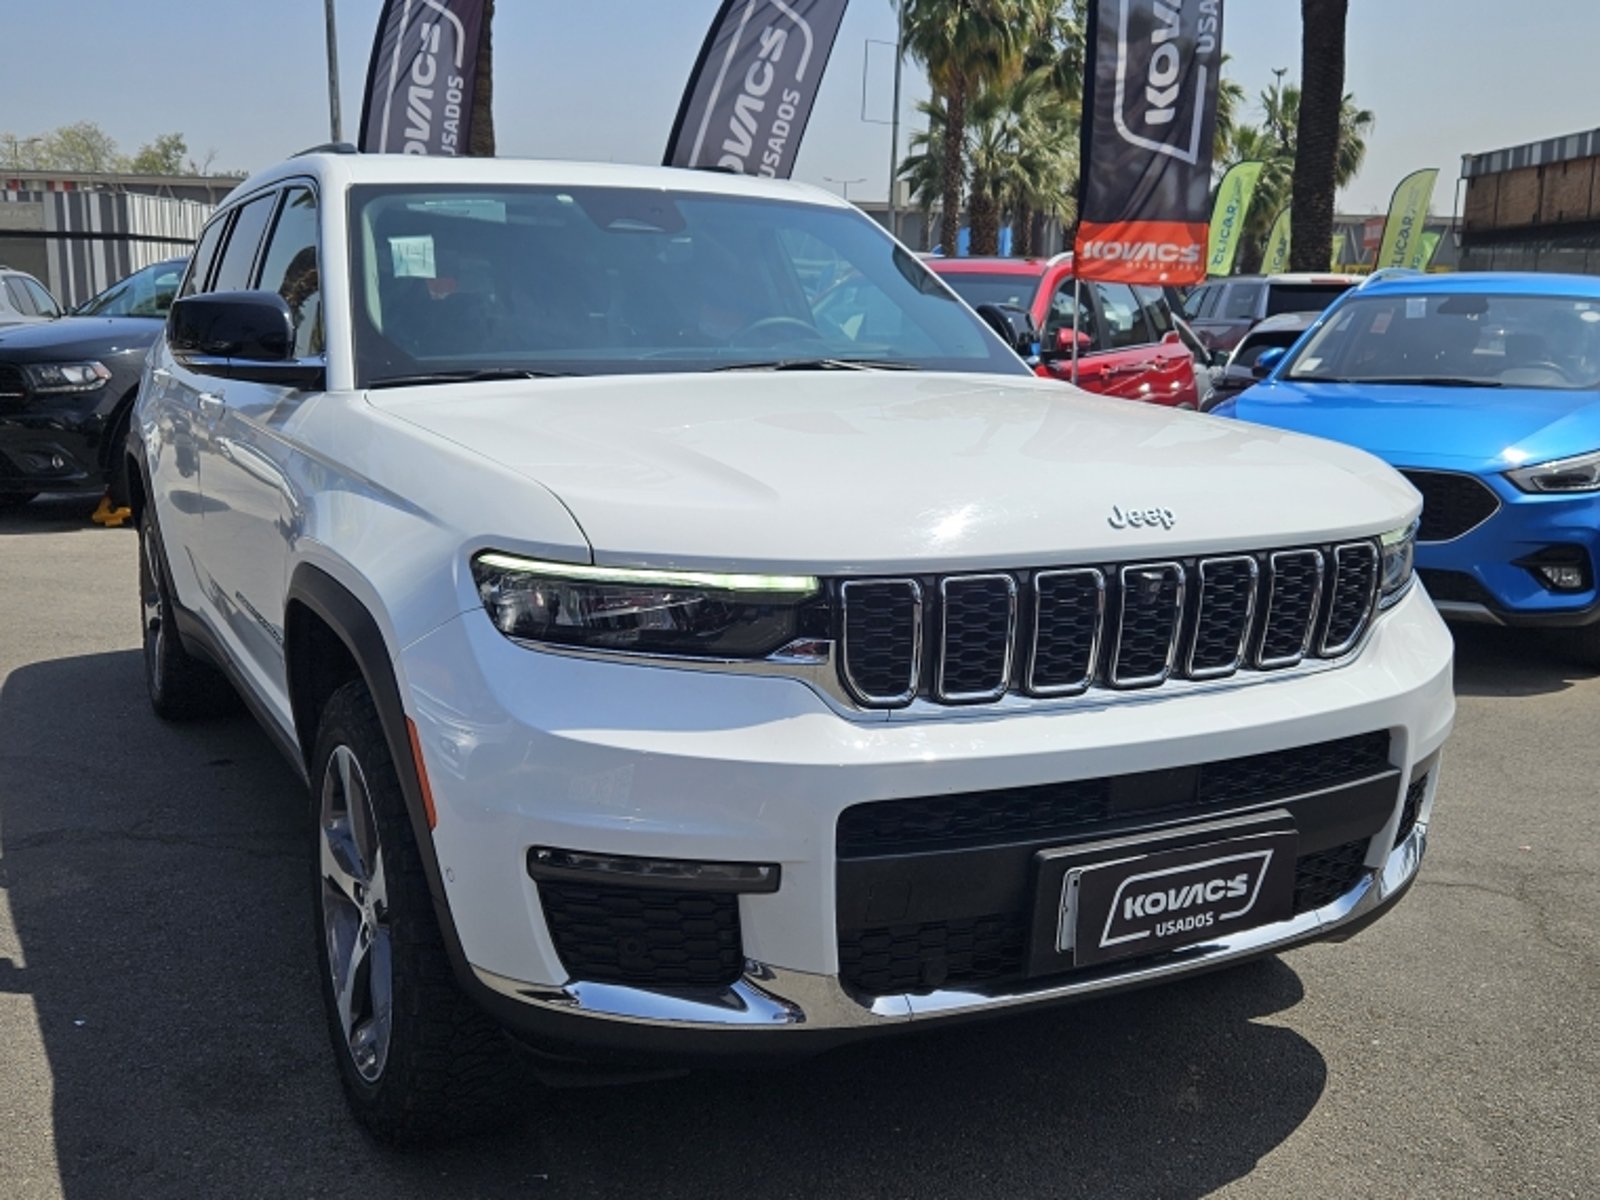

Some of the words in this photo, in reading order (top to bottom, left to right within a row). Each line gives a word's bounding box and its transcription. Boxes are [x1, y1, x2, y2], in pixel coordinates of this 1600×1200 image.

[1195, 0, 1218, 54] USA
[403, 22, 441, 155] VACS
[1144, 0, 1180, 125] KOV
[717, 25, 788, 174] VACS
[757, 88, 800, 179] USADOS
[1083, 241, 1201, 263] KOVACS
[1391, 215, 1413, 267] LICAR
[1107, 504, 1176, 531] Jeep
[1123, 873, 1249, 921] KOVACS
[1155, 911, 1214, 938] USADOS
